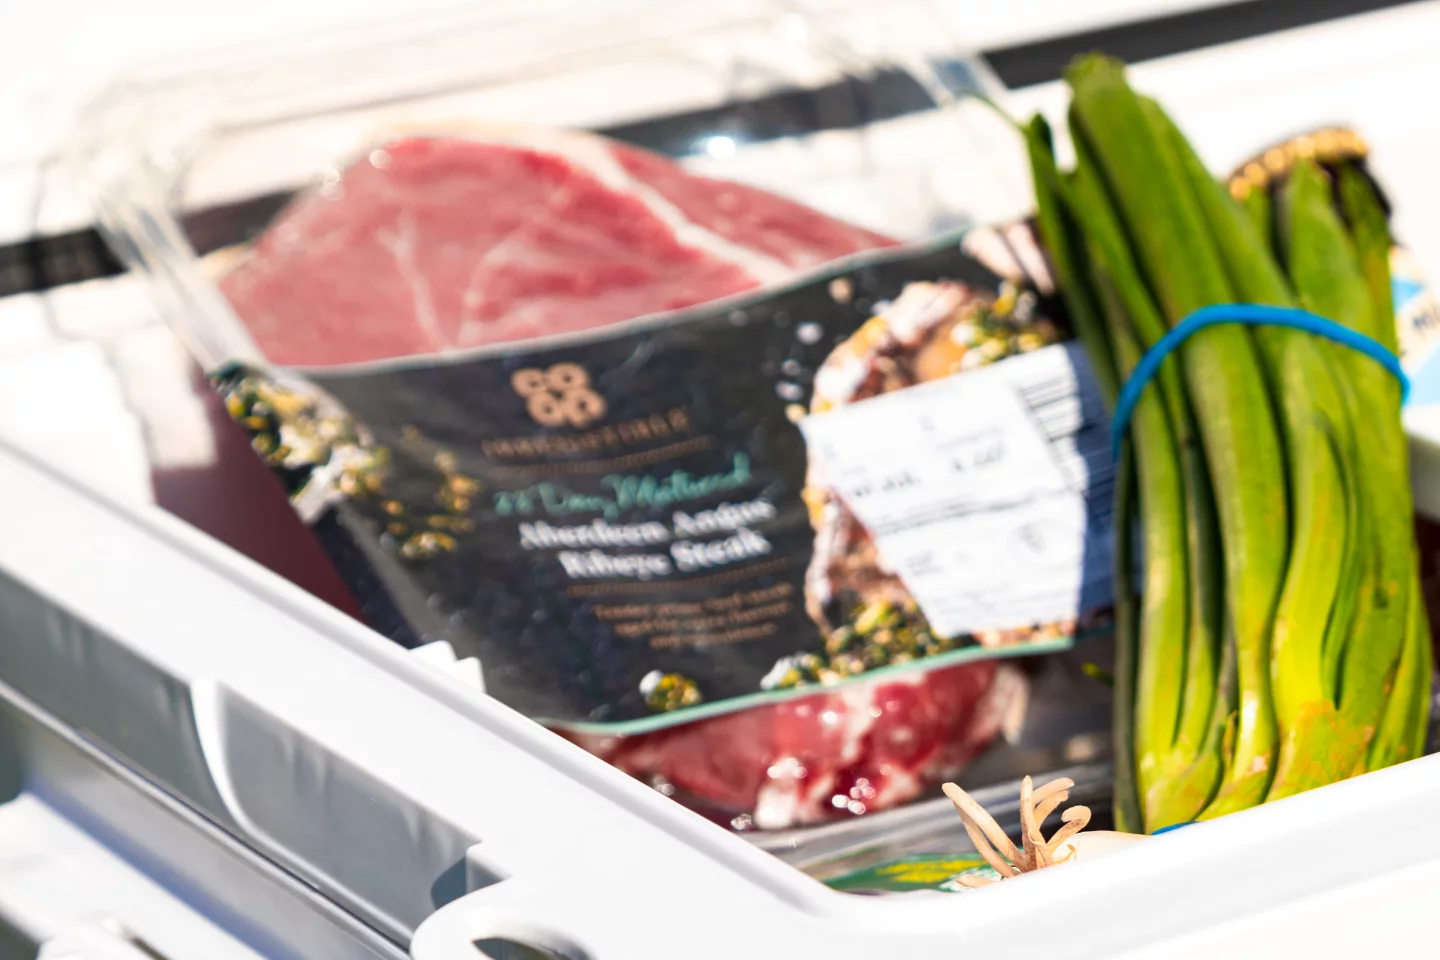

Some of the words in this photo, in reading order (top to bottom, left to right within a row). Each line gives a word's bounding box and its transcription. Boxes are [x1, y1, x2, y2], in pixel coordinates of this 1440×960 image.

[519, 518, 669, 550] Aberdeen
[672, 498, 777, 538] Angus
[558, 548, 672, 581] Ribeye
[670, 527, 772, 572] Steak
